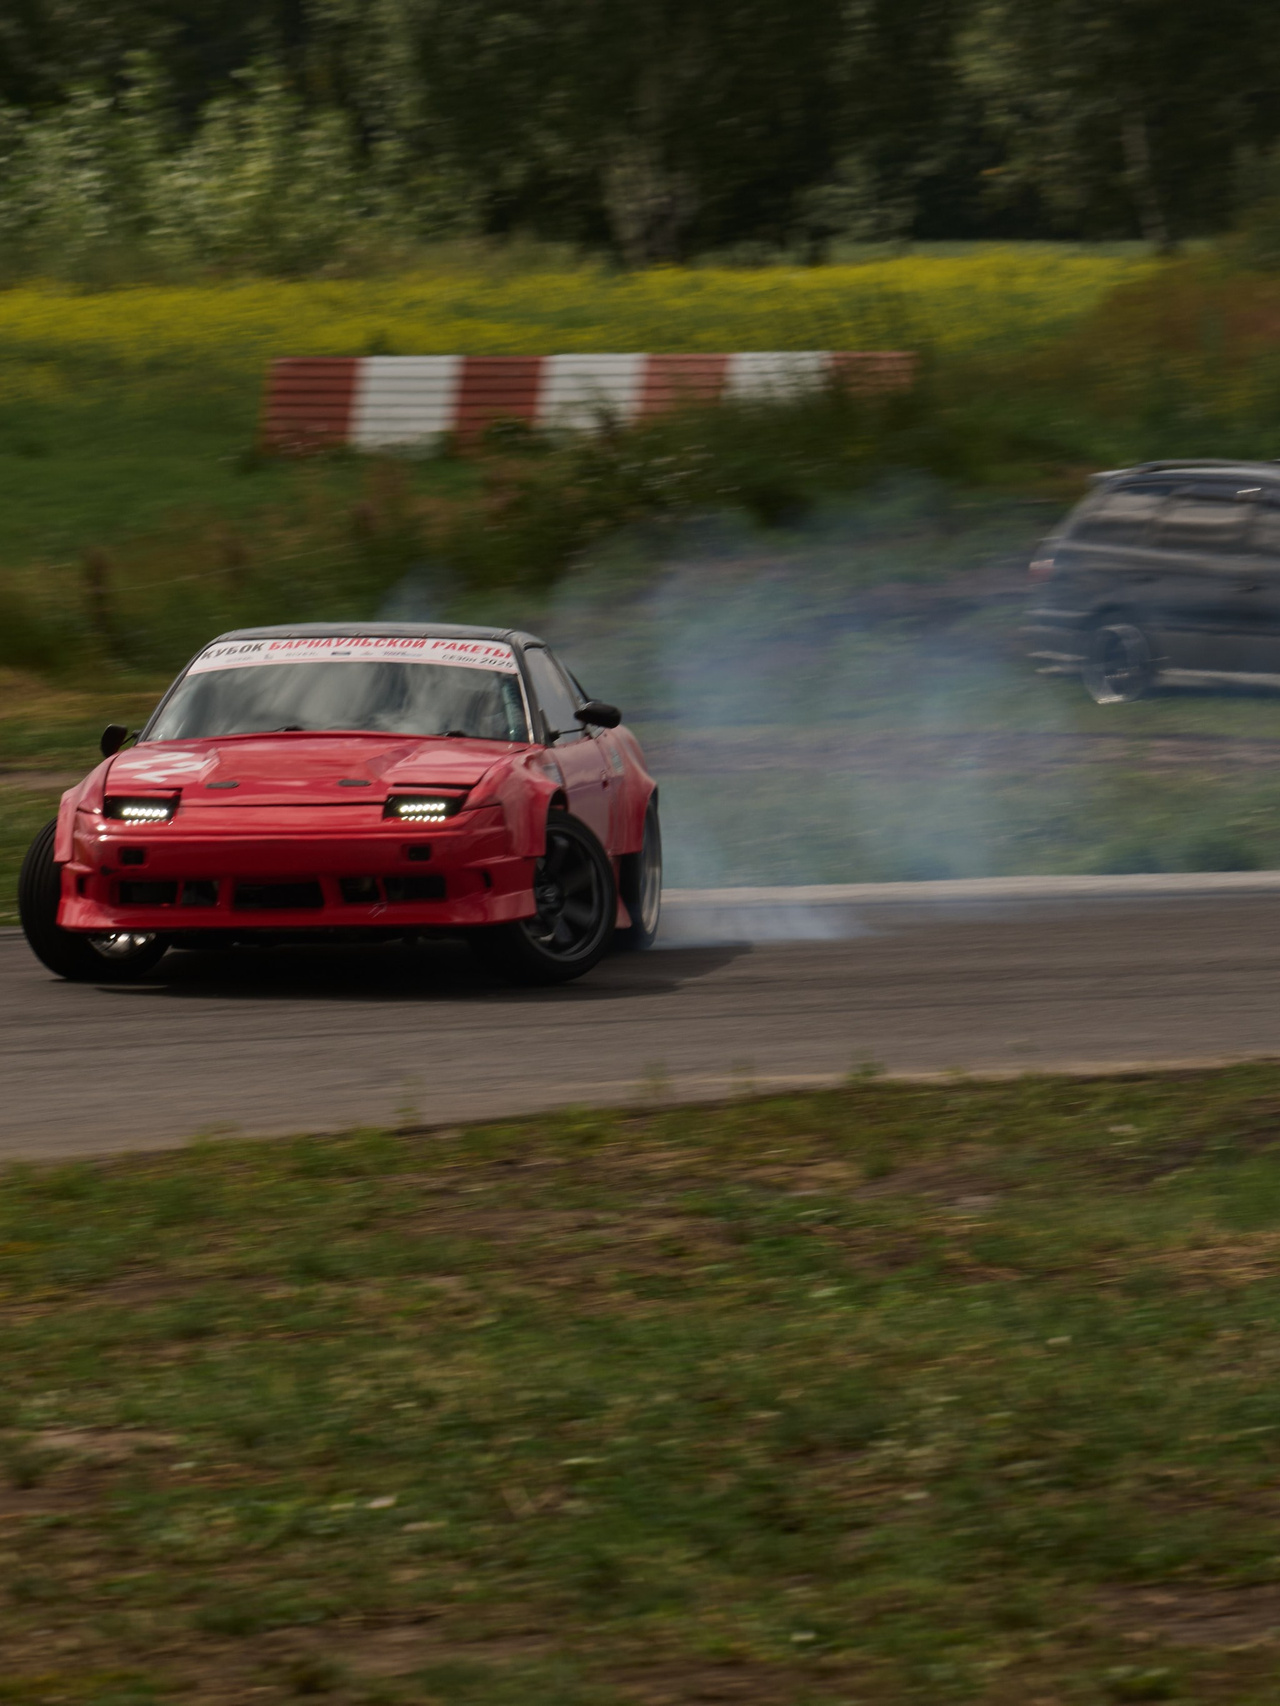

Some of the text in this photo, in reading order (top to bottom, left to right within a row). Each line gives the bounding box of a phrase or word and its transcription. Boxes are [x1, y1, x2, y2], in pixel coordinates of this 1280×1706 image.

[200, 637, 513, 660] КУБОК БАРНАУЛЬСКОЙ РАКЕТЫ
